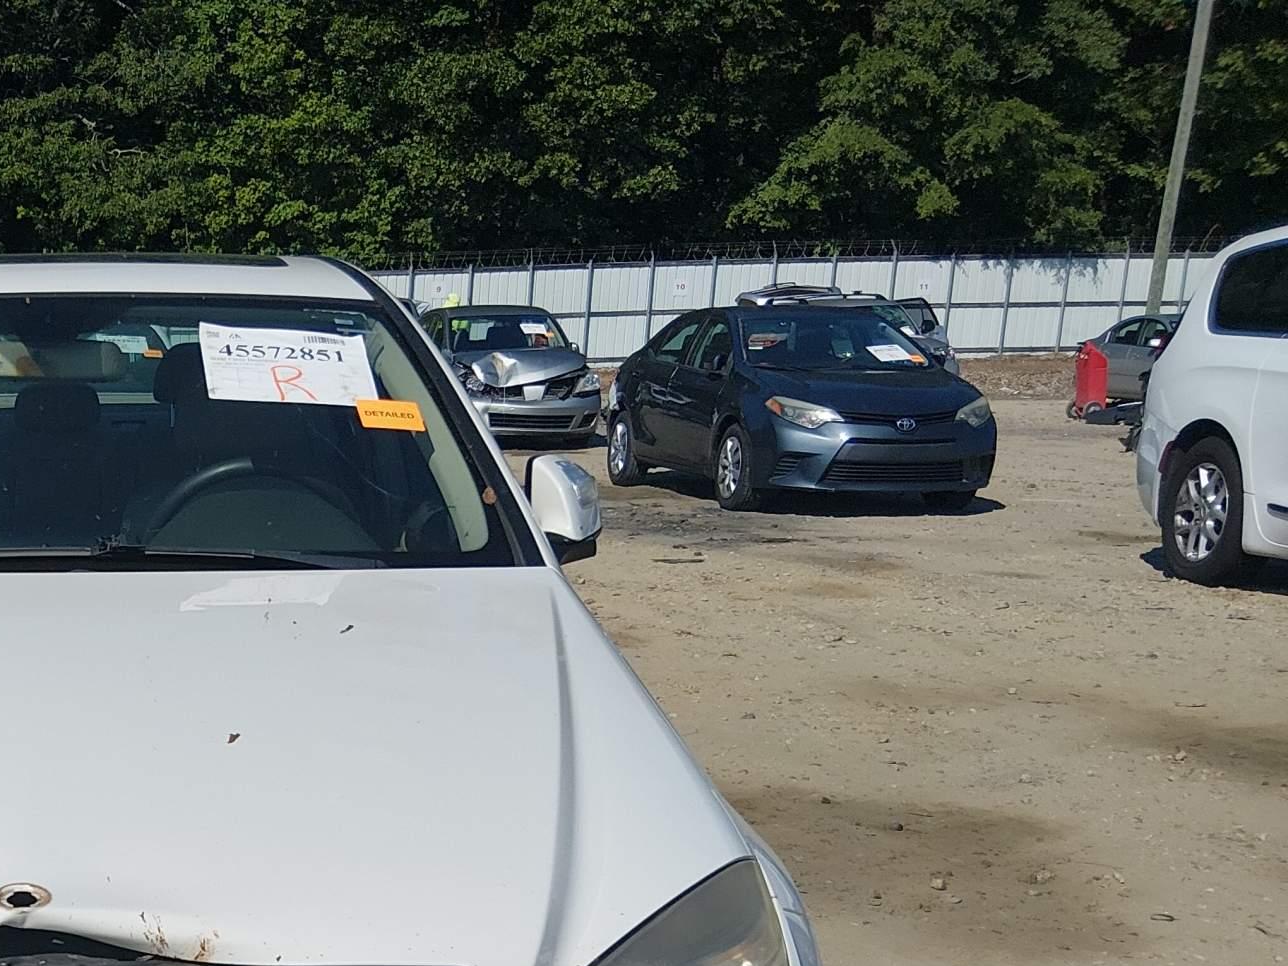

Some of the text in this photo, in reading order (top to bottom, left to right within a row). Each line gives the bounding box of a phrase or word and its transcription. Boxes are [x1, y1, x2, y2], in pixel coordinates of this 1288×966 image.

[919, 283, 928, 291] 11
[218, 343, 344, 363] 45572851
[270, 364, 318, 402] R
[364, 410, 415, 420] DETAILED
